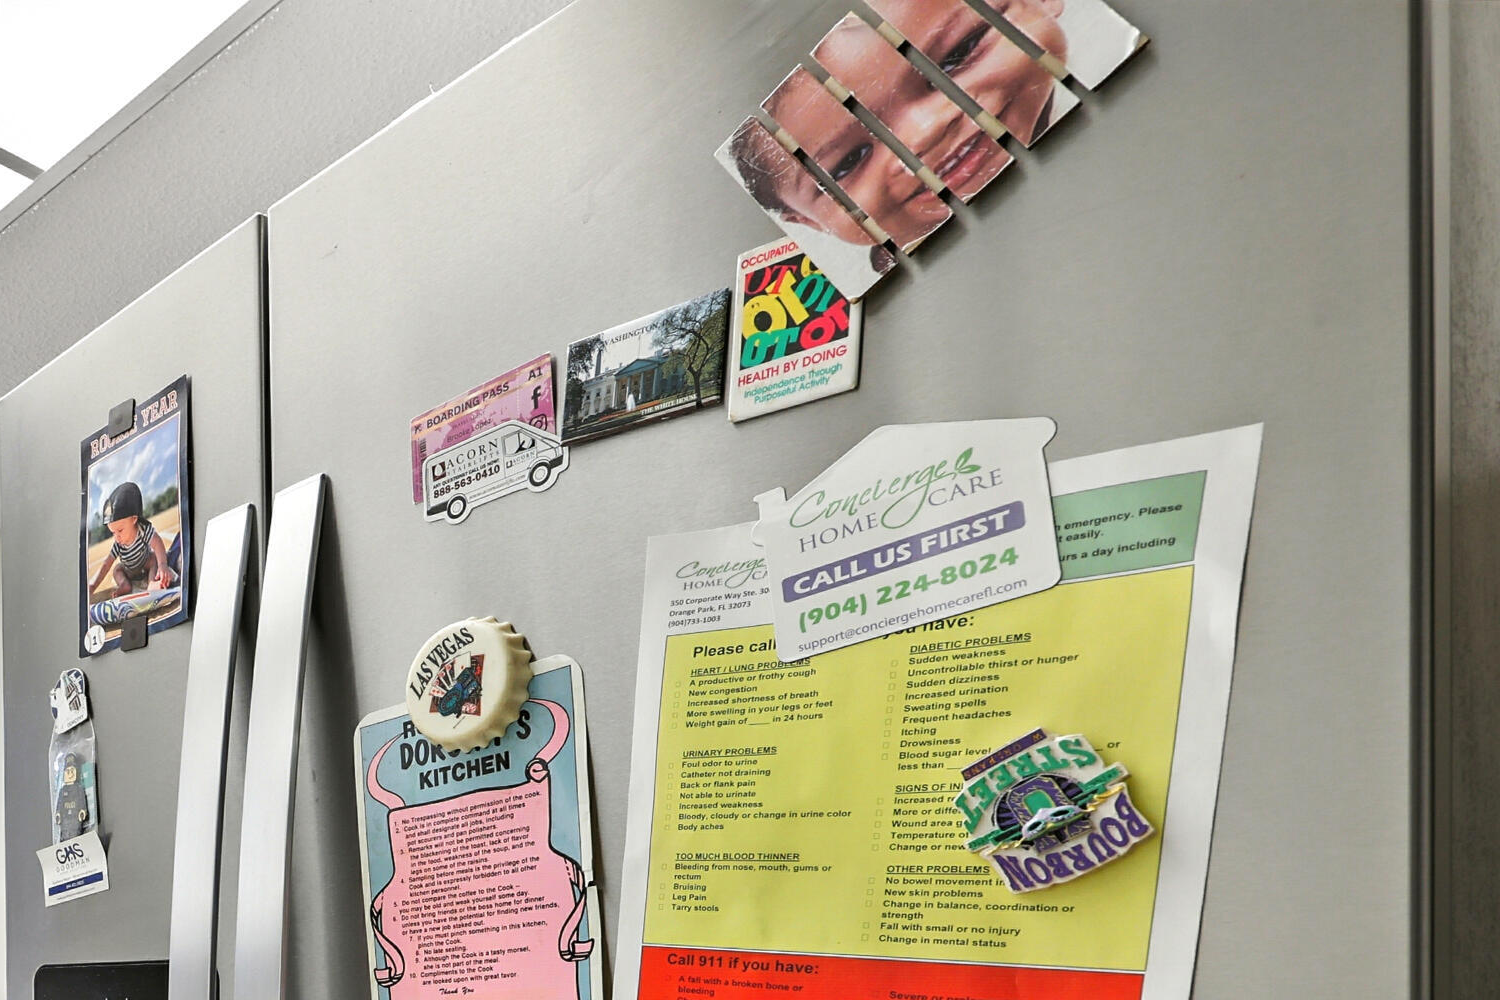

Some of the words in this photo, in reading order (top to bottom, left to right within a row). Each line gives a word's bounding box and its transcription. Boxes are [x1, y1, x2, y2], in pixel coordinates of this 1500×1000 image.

[741, 242, 800, 270] OCCUPATIO
[528, 367, 543, 381] A1
[738, 365, 779, 387] HEALTH
[783, 358, 798, 373] BY
[802, 344, 847, 368] DOING
[744, 372, 805, 399] Independence
[808, 362, 843, 379] Through
[754, 386, 797, 405] Purposeful
[799, 376, 831, 392] Activity
[140, 390, 179, 427] YEAR
[426, 396, 480, 429] BOARDING
[482, 381, 510, 402] PASS
[447, 439, 499, 470] ACORN
[433, 464, 500, 498] 888-563-0410
[790, 459, 948, 529] Concierge
[798, 513, 878, 553] HOME
[928, 468, 1004, 507] CARE
[1063, 512, 1134, 530] emergency.
[1138, 503, 1183, 517] Please
[1065, 529, 1104, 542] easily.
[793, 560, 867, 595] CALL
[873, 542, 912, 569] US
[921, 509, 1011, 554] FIRST
[1080, 551, 1088, 559] a
[1091, 547, 1114, 557] day
[1117, 536, 1177, 553] including
[683, 578, 725, 591] HOME
[799, 594, 867, 633] (904)
[876, 547, 1019, 606] 224-8024
[669, 609, 696, 617] Orange
[697, 605, 717, 614] Park,
[727, 600, 752, 610] 32073
[670, 599, 685, 607] 350
[685, 595, 723, 605] Corporate
[724, 592, 742, 600] Way
[667, 614, 721, 629] (904)733-1003
[798, 578, 1028, 653] support@conciergehomecarefl.com
[693, 644, 744, 658] Please
[749, 638, 777, 653] call
[909, 640, 964, 655] DIABETIC
[963, 632, 1032, 649] PROBLEMS
[410, 663, 433, 700] LAS
[426, 627, 475, 668] VEGAS
[907, 662, 985, 677] Uncontrollable
[988, 659, 1018, 669] thirst
[1021, 658, 1034, 666] or
[1036, 654, 1079, 665] hunger
[908, 654, 949, 665] Sudden
[951, 649, 1007, 661] weakness
[689, 679, 696, 687] A
[697, 675, 745, 688] productive
[758, 671, 786, 681] frothy
[787, 668, 817, 678] cough
[688, 689, 708, 697] New
[708, 685, 758, 696] congestion
[900, 726, 937, 736] Itching
[682, 748, 724, 759] URINARY
[723, 745, 777, 757] PROBLEMS
[899, 738, 961, 748] Drowsiness
[419, 751, 511, 790] KITCHEN
[681, 760, 701, 769] Foul
[701, 759, 723, 768] odor
[724, 759, 734, 767] to
[734, 758, 758, 766] urine
[955, 738, 1097, 834] STREET
[410, 811, 446, 823] Trespassing
[446, 805, 469, 816] without
[469, 799, 504, 813] permission
[512, 794, 523, 802] the
[677, 823, 698, 832] Body
[699, 823, 725, 831] aches
[993, 792, 1149, 891] BOURBON
[675, 852, 695, 861] TOO
[693, 852, 722, 861] MUCH
[721, 852, 757, 861] BLOOD
[755, 852, 800, 861] THINNER
[885, 864, 926, 874] OTHER
[924, 865, 991, 874] PROBLEMS
[672, 882, 707, 892] Bruising
[884, 888, 907, 897] New
[908, 888, 930, 897] skin
[932, 889, 984, 899] problems
[672, 893, 687, 903] Leg
[688, 893, 707, 901] Pain
[419, 969, 458, 978] Compliments
[477, 965, 494, 973] Cook
[667, 953, 695, 966] Call
[698, 954, 723, 968] 911
[728, 956, 740, 969] if
[741, 960, 770, 973] you
[774, 959, 819, 974] have:
[438, 987, 458, 995] Thank
[461, 986, 475, 995] You
